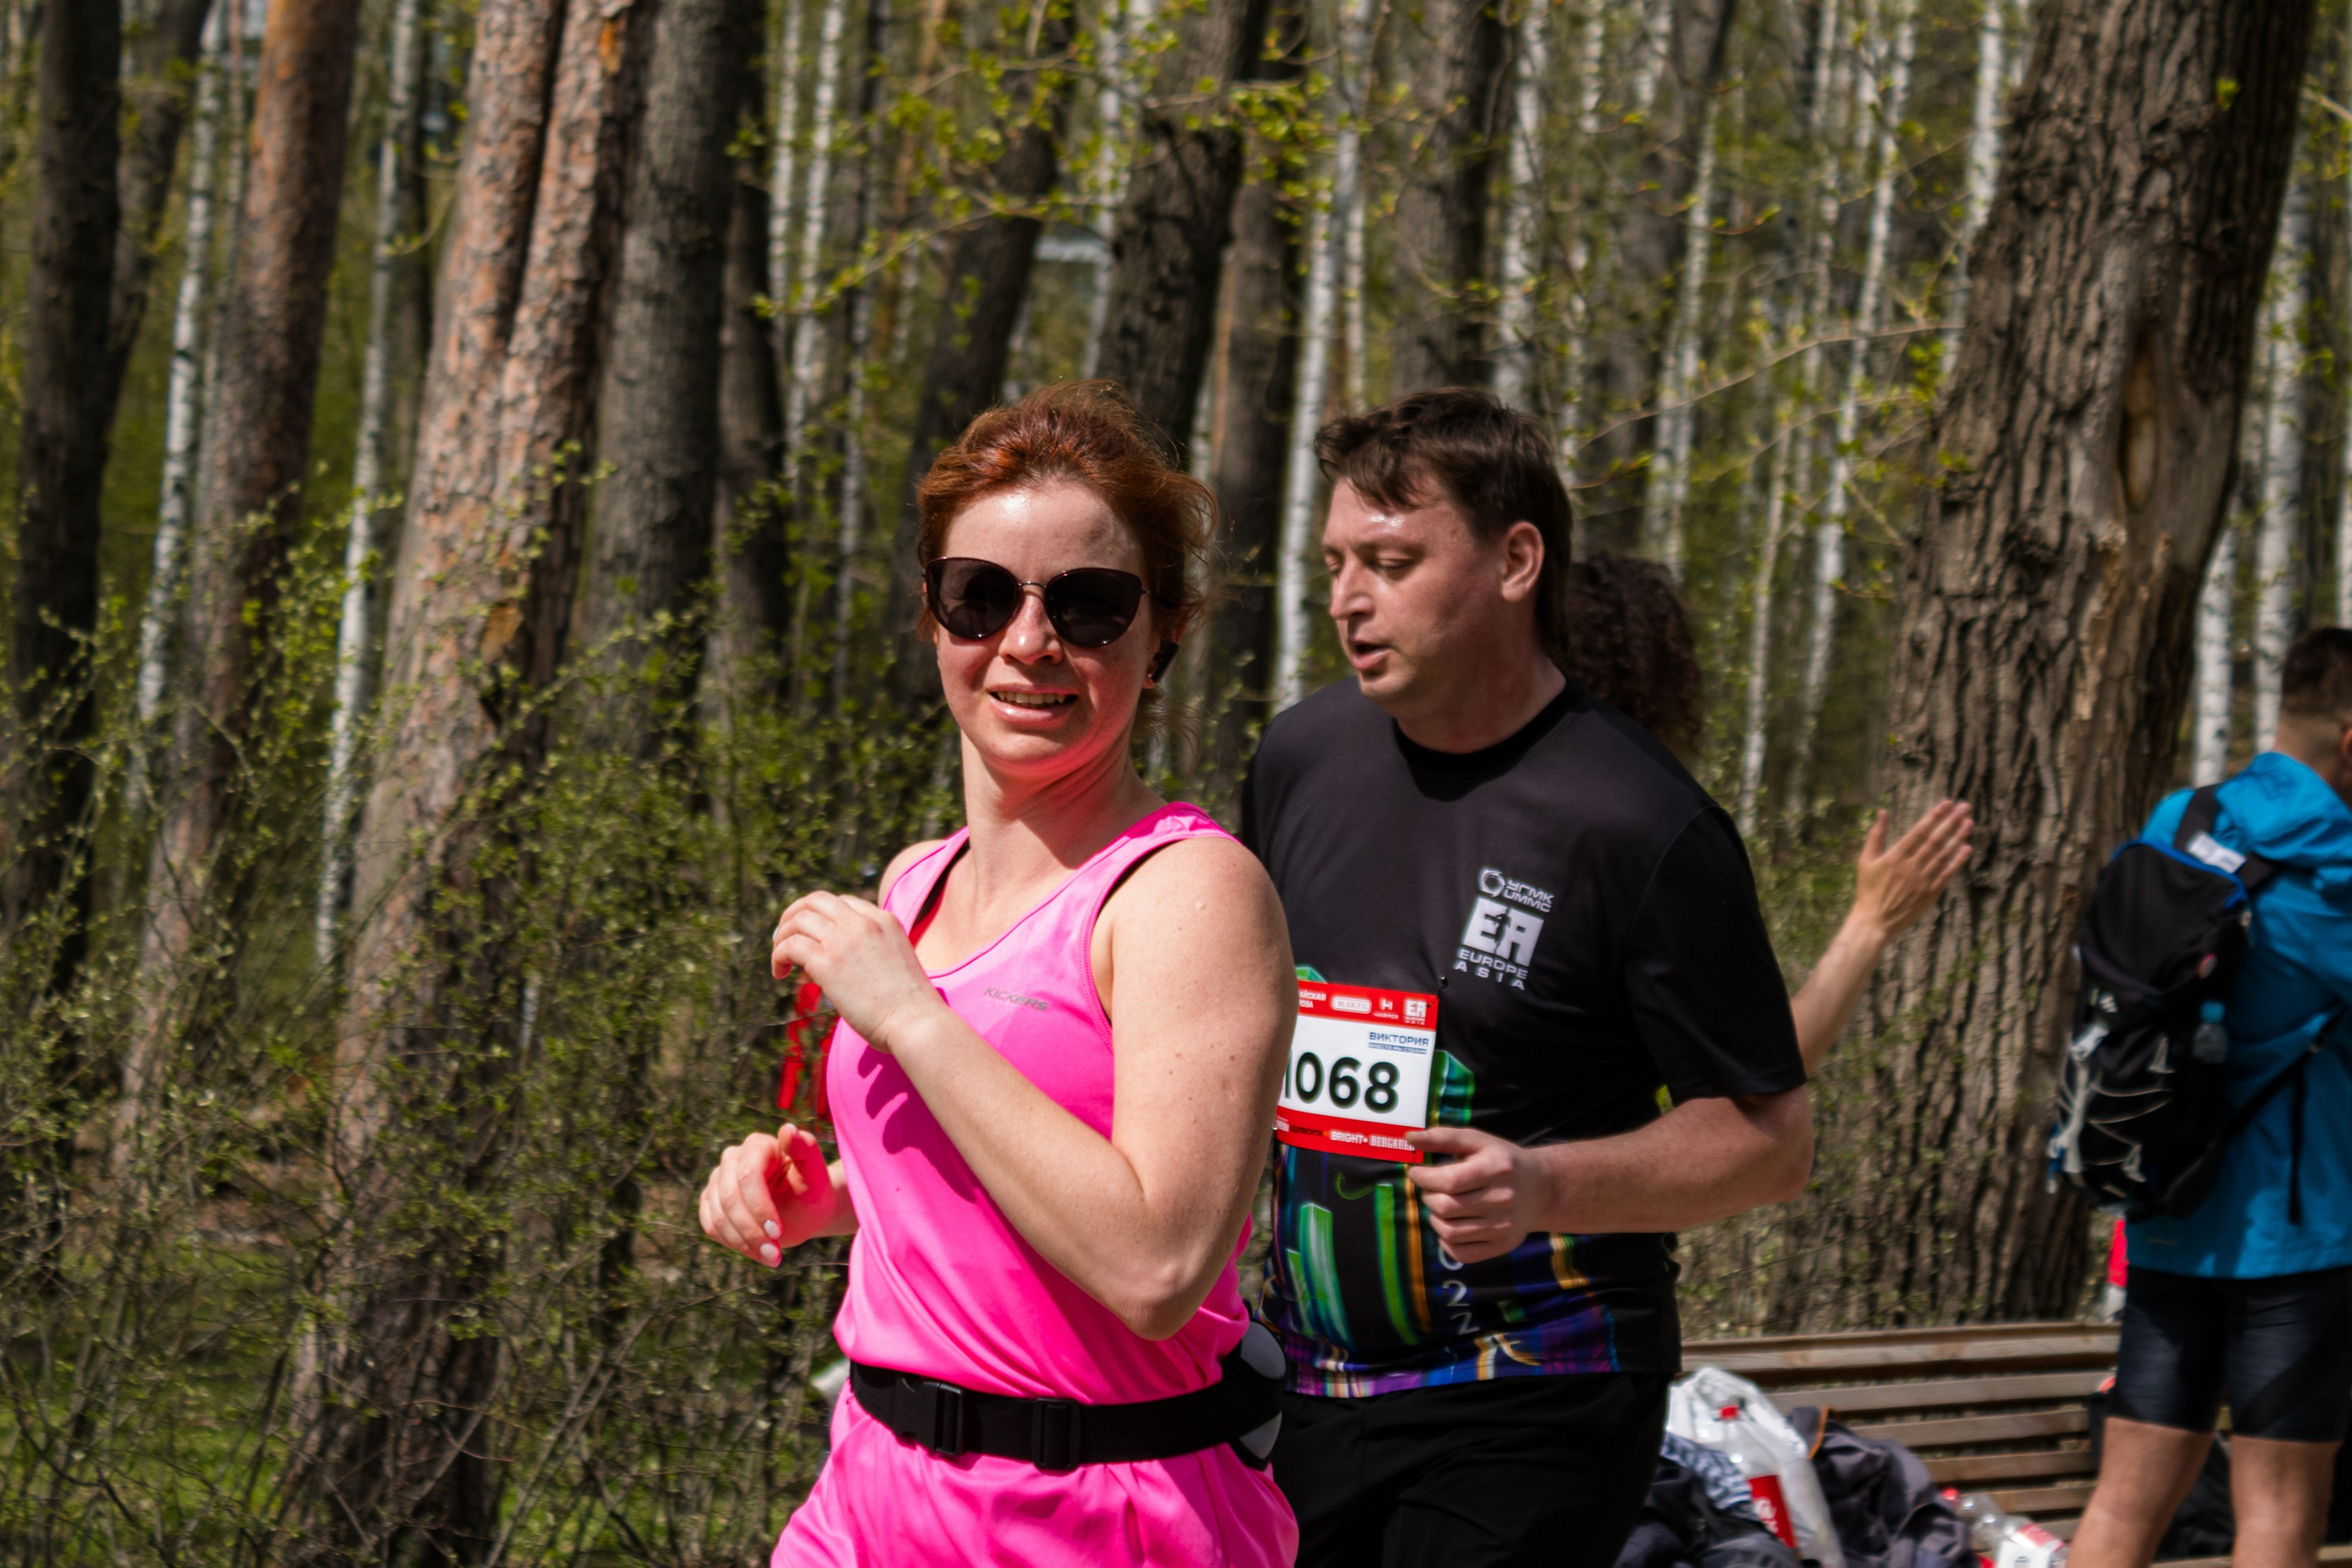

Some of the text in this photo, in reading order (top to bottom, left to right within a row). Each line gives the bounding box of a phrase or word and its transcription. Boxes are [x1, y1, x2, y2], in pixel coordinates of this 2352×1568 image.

[1503, 889, 1552, 913] UMMC
[1506, 880, 1555, 904] УГМК
[1463, 897, 1544, 967] EA
[1453, 961, 1525, 990] ASIA
[1458, 948, 1529, 980] EUROPE
[983, 987, 1050, 1011] KICKERS
[1298, 989, 1327, 1001] АЙСКАЯ
[1369, 1032, 1430, 1047] ВИКТОРИЯ
[1329, 1130, 1364, 1145] BRIGHT
